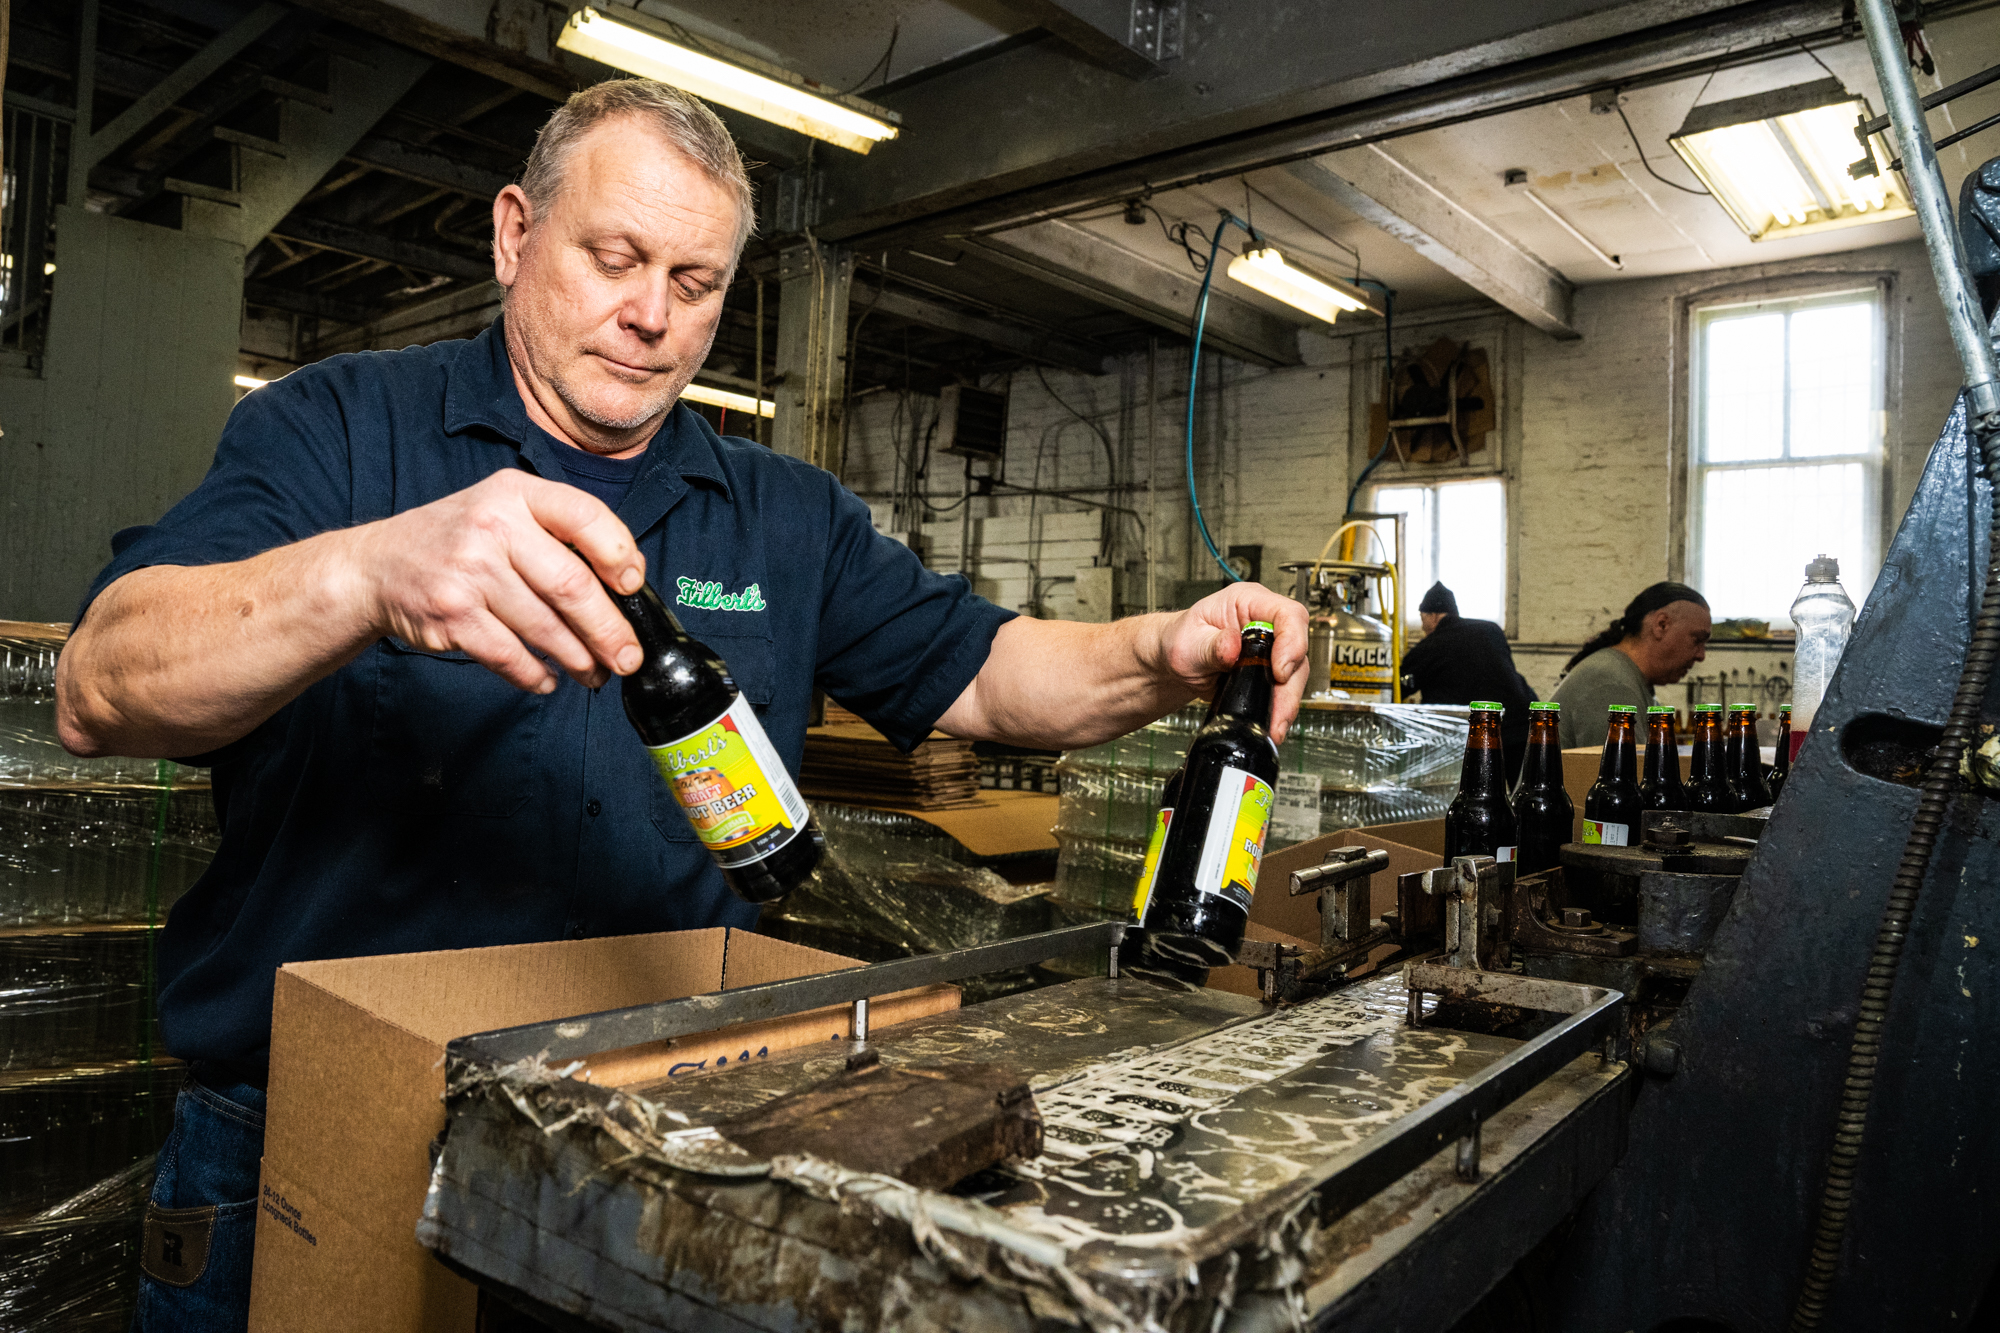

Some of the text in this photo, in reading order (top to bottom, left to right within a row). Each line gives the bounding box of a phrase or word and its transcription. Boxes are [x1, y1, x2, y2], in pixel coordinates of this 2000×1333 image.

[677, 576, 766, 611] Filbert's
[661, 732, 727, 772] ilbert's
[683, 783, 722, 804] DRAFT
[710, 783, 758, 815] BEER
[1244, 838, 1263, 862] ROO
[263, 1198, 317, 1246] Longneck Bottles
[281, 1197, 302, 1221] Ounce
